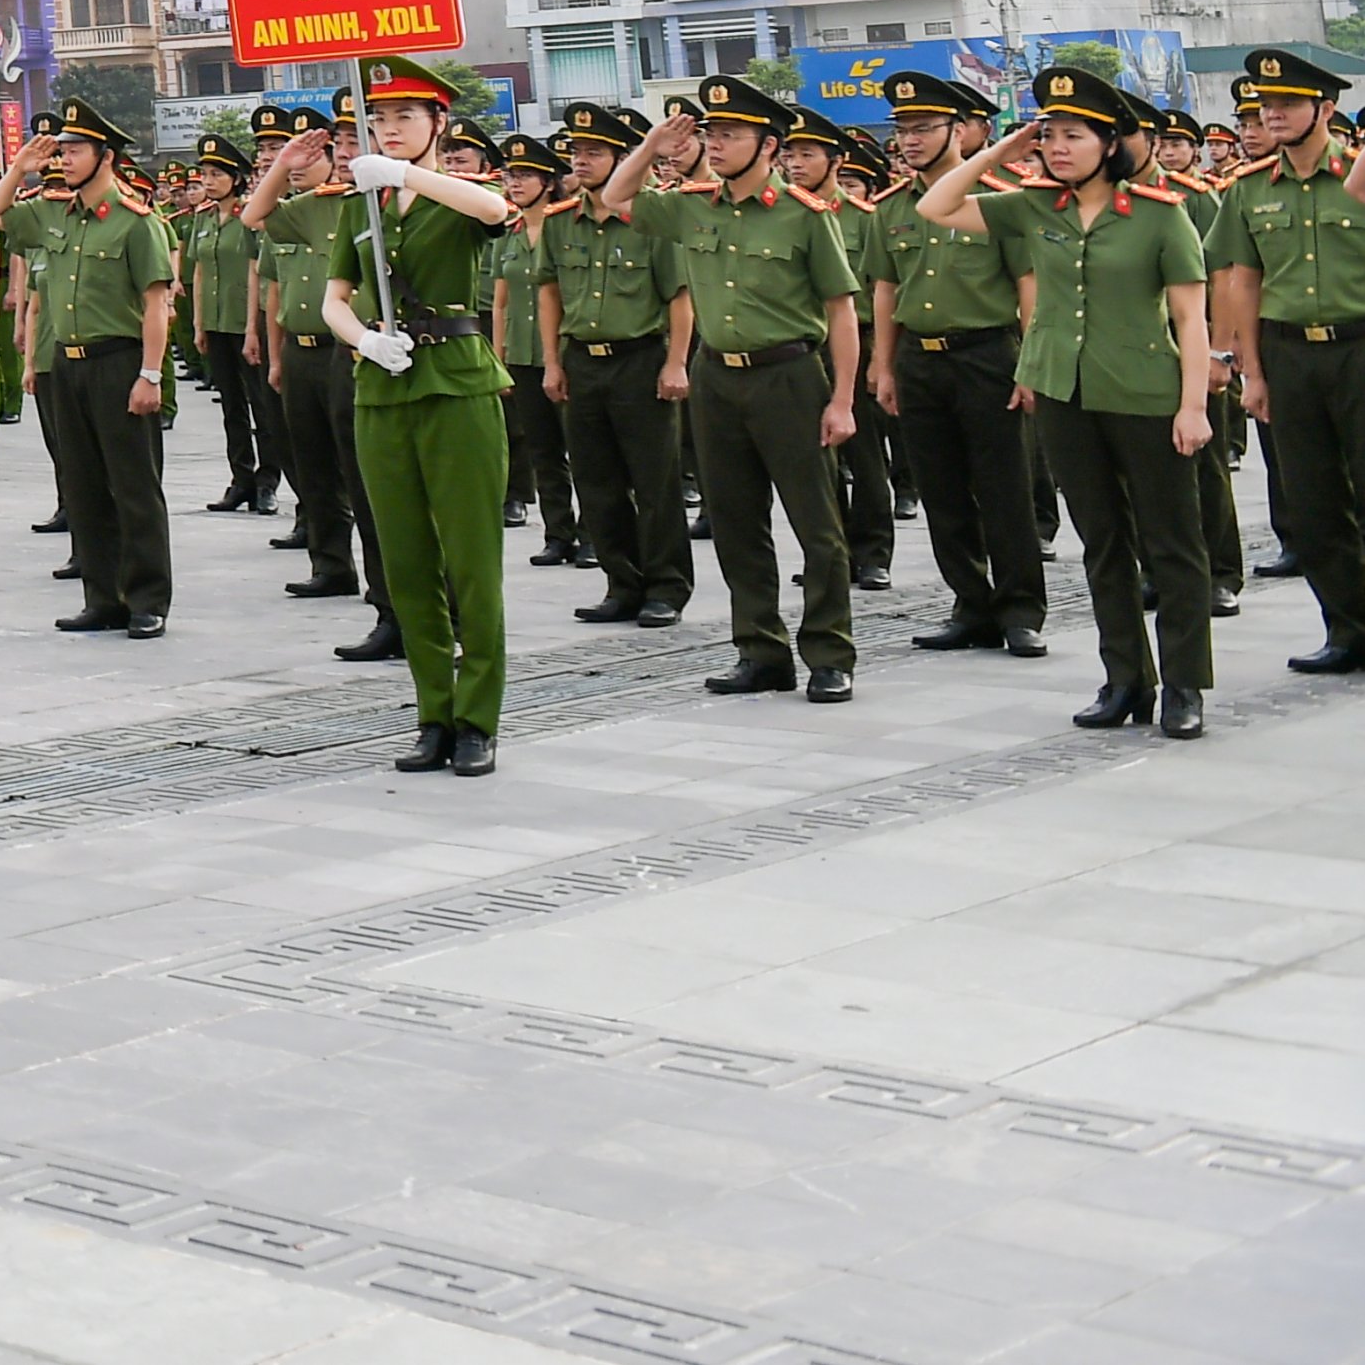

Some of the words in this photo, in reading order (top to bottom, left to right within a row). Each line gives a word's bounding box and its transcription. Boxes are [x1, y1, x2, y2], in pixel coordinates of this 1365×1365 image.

[253, 18, 289, 48] AN
[294, 11, 368, 43] NINH,
[373, 4, 441, 37] XDLL
[821, 81, 858, 99] Life
